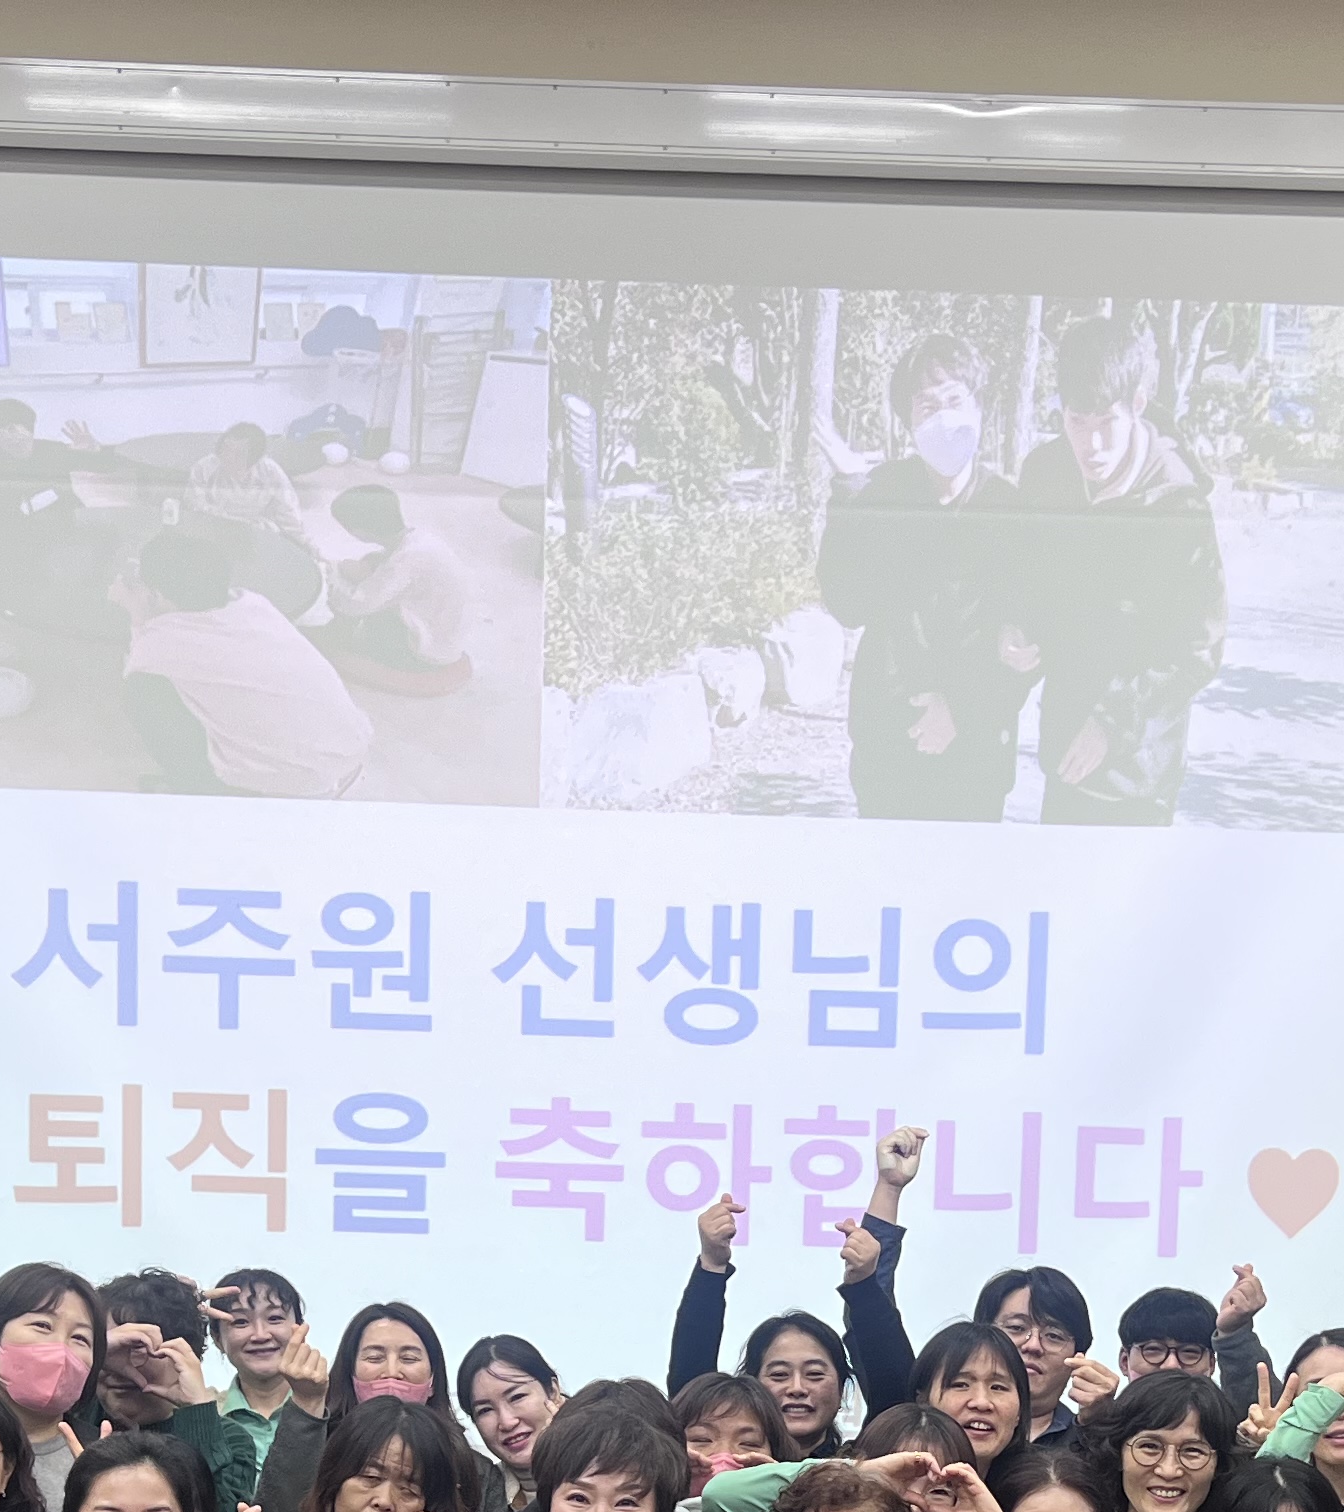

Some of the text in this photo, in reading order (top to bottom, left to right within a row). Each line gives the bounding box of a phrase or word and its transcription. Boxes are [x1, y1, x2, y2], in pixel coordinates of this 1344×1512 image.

[11, 881, 1050, 1055] 서주원 선생님의
[495, 1096, 1204, 1258] 축하합니다
